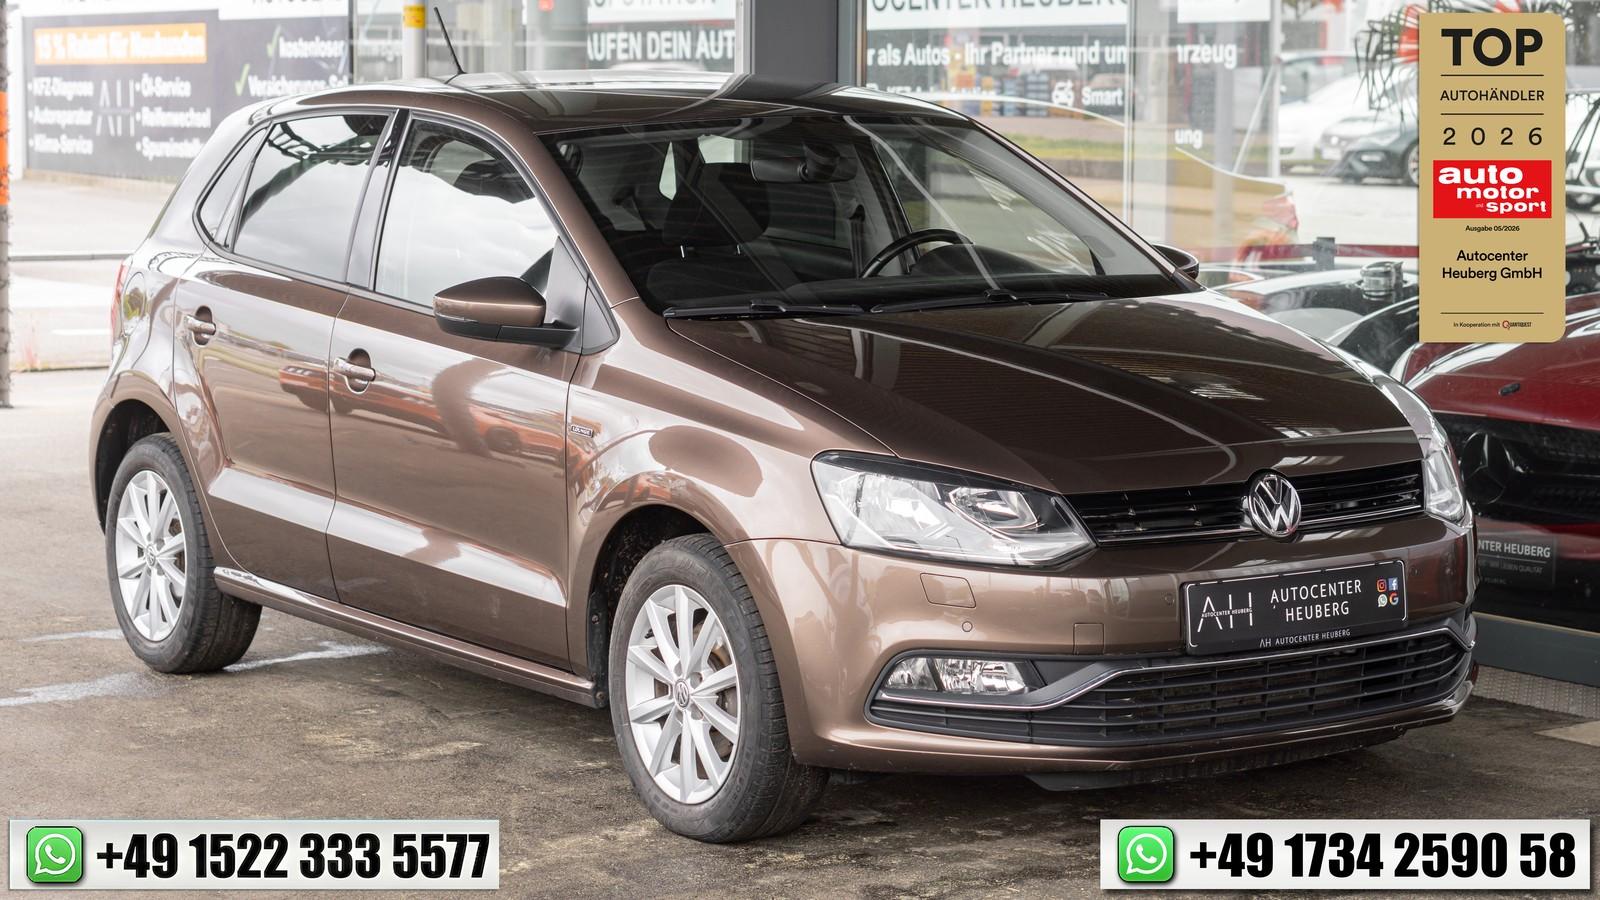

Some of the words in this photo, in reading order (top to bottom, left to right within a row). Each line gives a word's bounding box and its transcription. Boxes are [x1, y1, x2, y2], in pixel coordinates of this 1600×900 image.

[646, 31, 691, 60] DEIN
[695, 29, 735, 60] AUT
[877, 42, 902, 66] als
[903, 42, 951, 66] Autos
[964, 41, 989, 66] Ihr
[991, 41, 1057, 66] Partner
[1058, 40, 1100, 65] rund
[1081, 86, 1123, 106] Smart
[1503, 543, 1551, 558] HEUBERG
[1270, 579, 1363, 604] AUTOCENTER
[1285, 601, 1350, 622] HEUBERG
[1275, 633, 1320, 647] AUTOCENTER
[1321, 628, 1351, 640] HEUBERG
